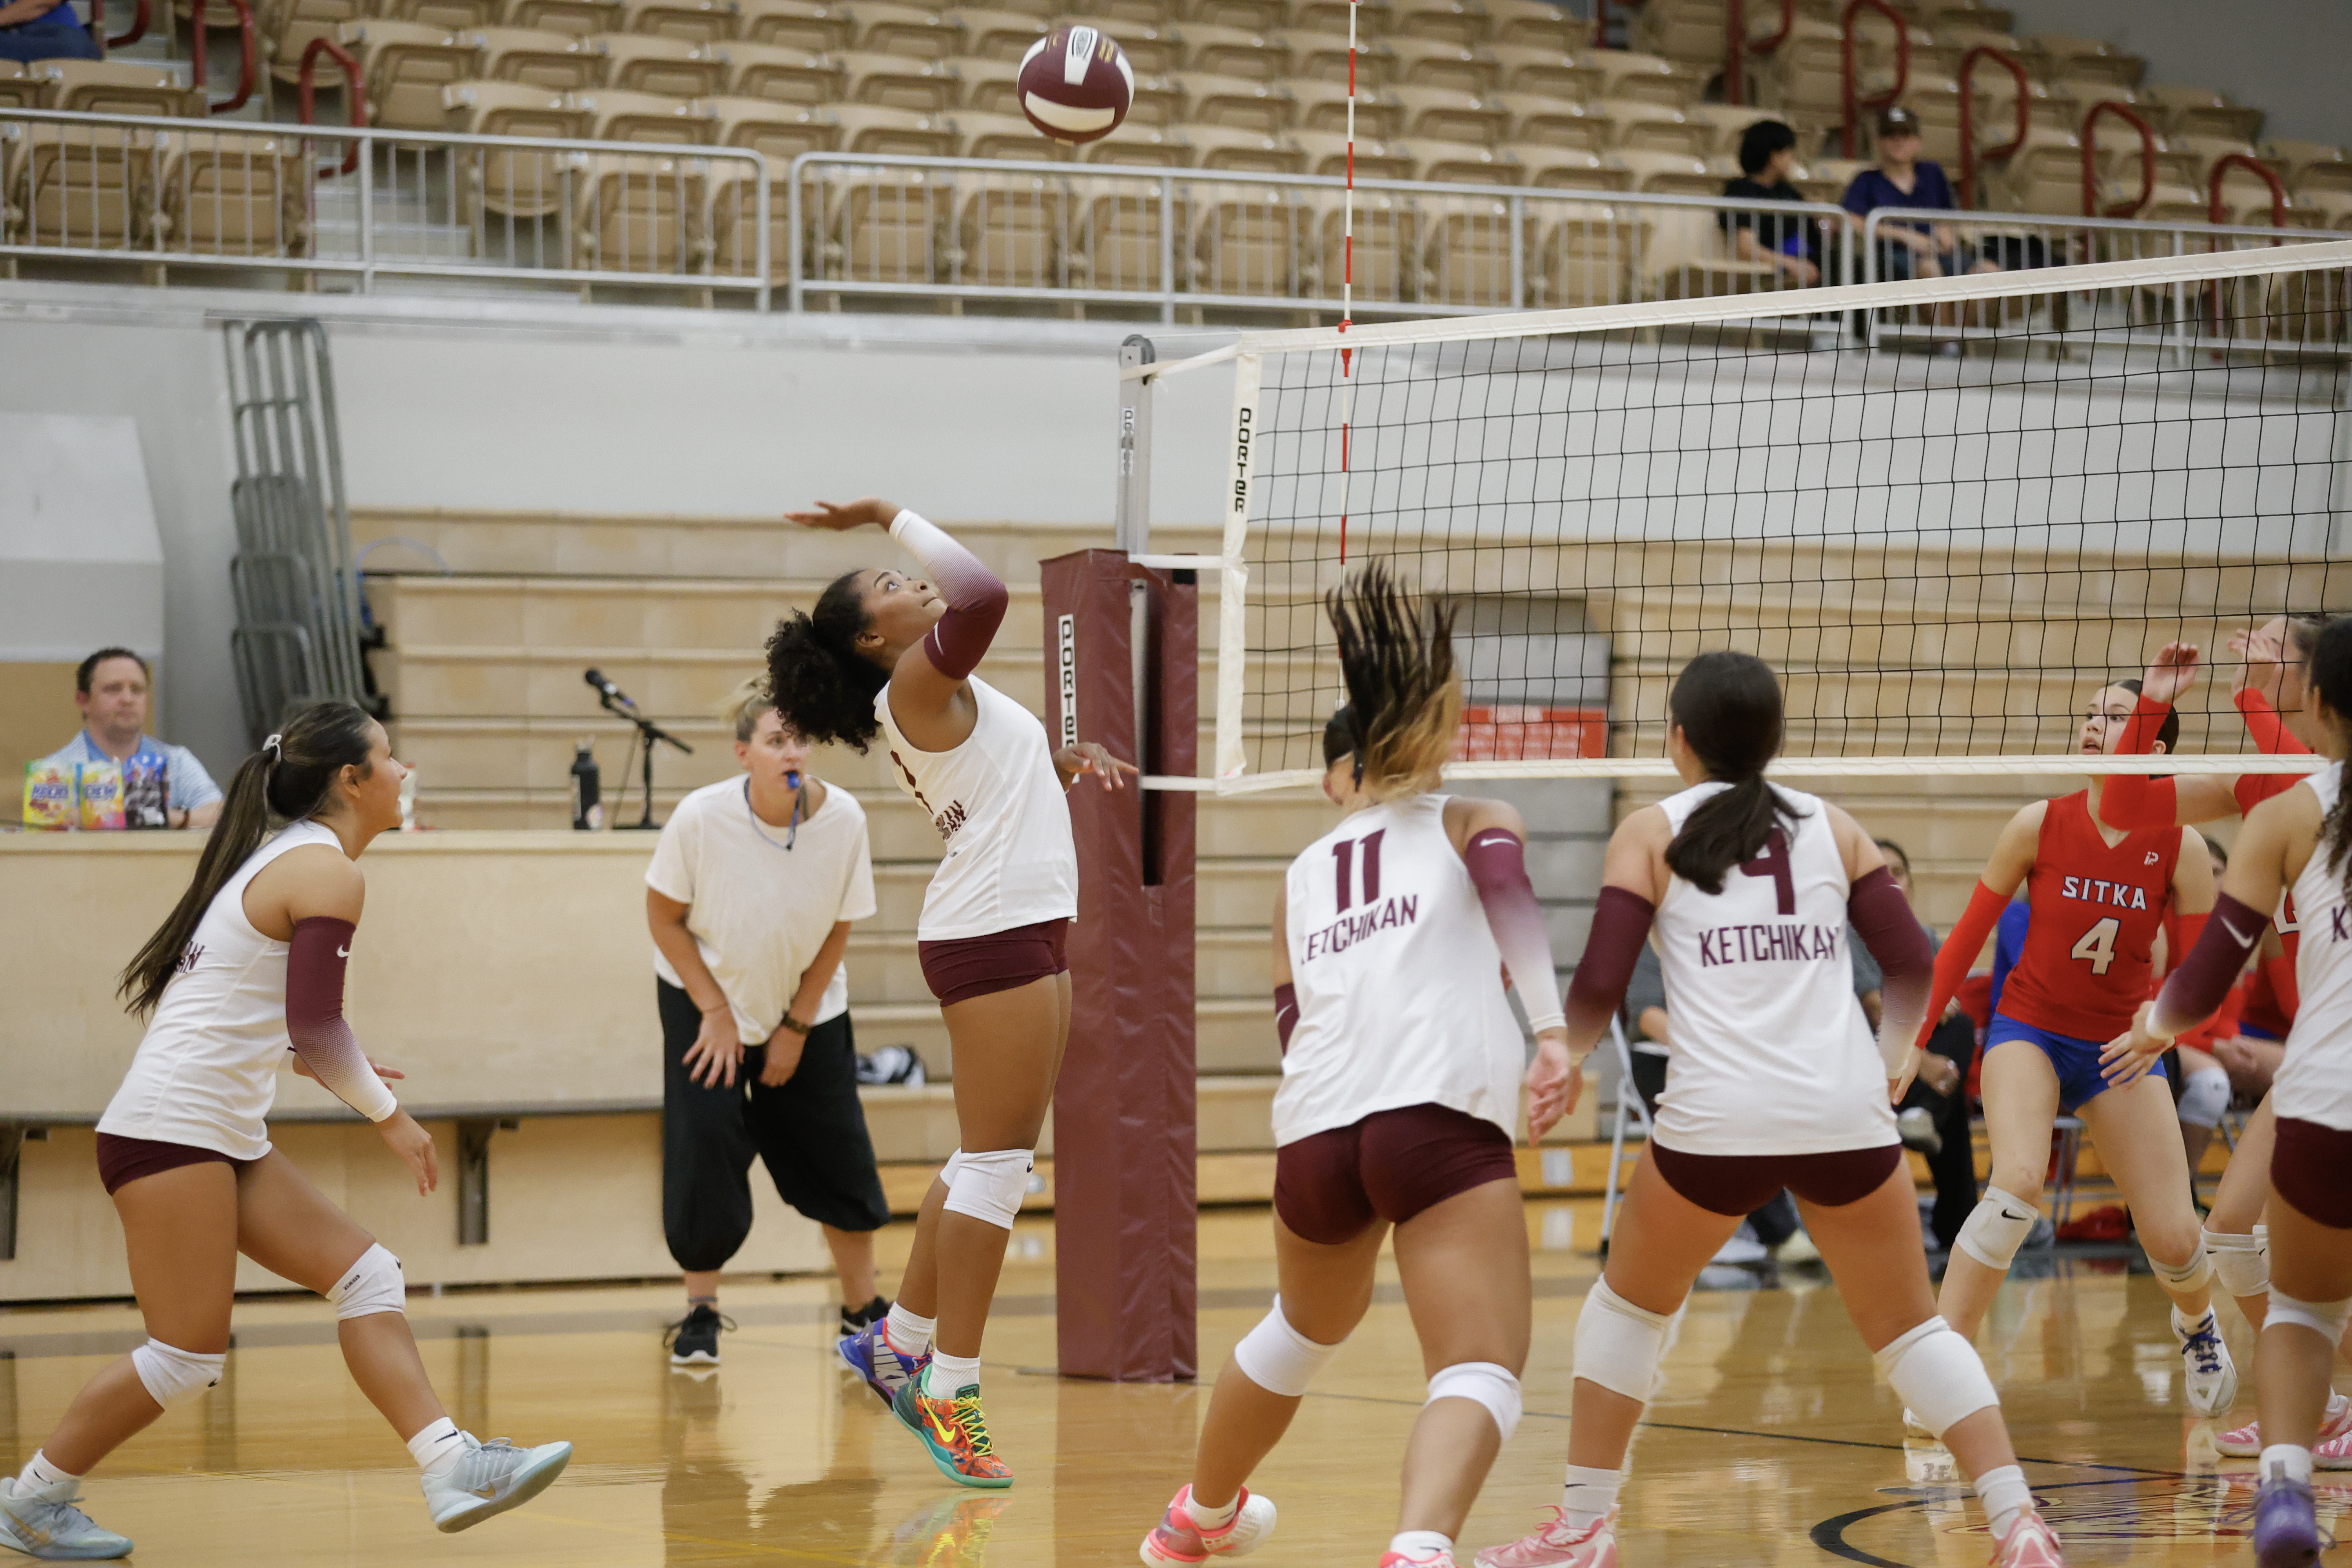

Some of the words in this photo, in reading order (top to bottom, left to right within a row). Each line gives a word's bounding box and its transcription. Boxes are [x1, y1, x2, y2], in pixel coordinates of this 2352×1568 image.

[1235, 408, 1251, 513] PORTER
[1332, 828, 1386, 915] 11
[1739, 827, 1796, 915] 4
[2061, 875, 2147, 911] SITKA
[1301, 893, 1418, 965] ETCHIKAN
[2071, 916, 2121, 975] 4
